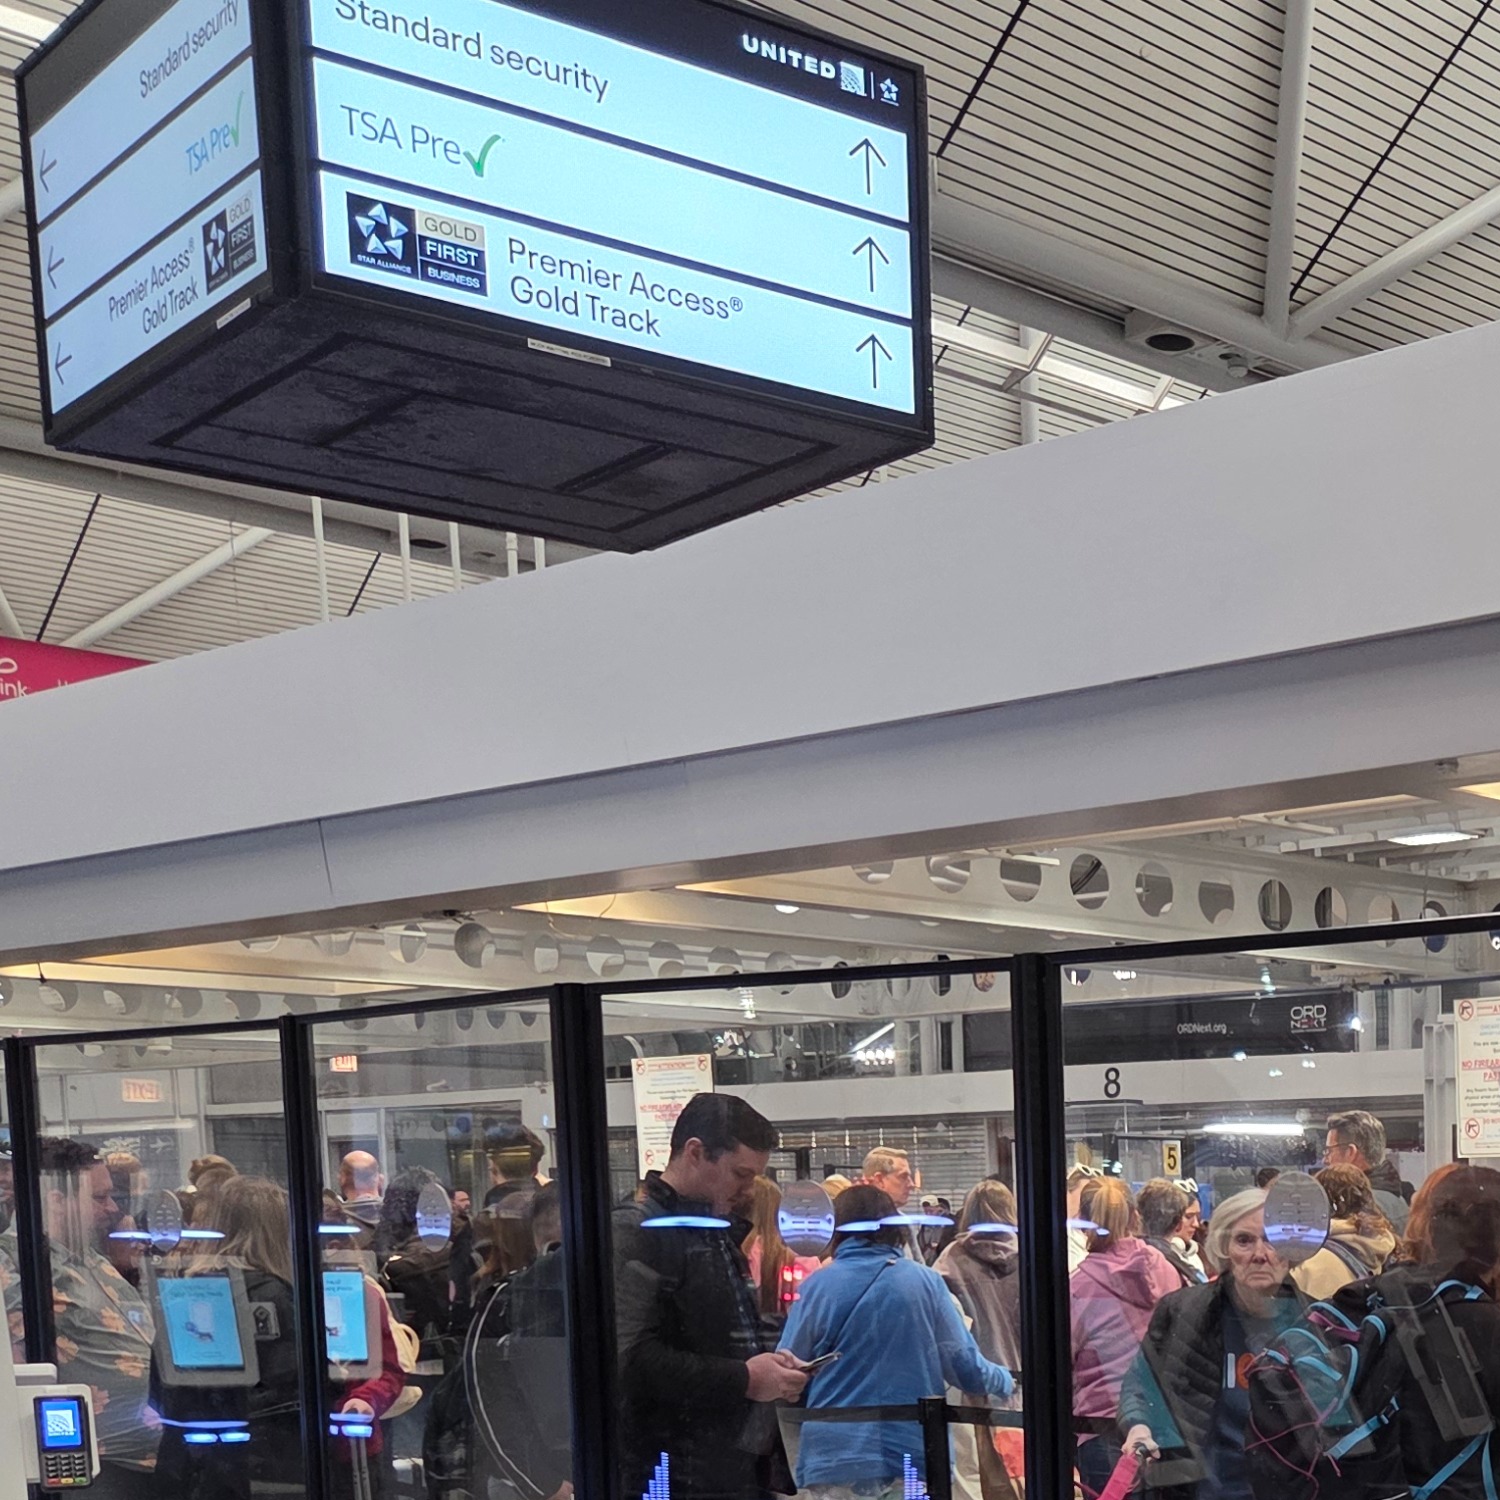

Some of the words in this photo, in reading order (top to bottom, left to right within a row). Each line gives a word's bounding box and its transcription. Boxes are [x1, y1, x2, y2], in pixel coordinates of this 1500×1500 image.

[139, 31, 191, 98] Standard
[191, 0, 238, 54] security
[335, 0, 482, 59] Standard
[490, 44, 608, 103] security
[742, 33, 836, 79] UNITED
[340, 105, 402, 149] TSA
[411, 125, 461, 164] Pre
[186, 137, 210, 175] TSA
[210, 124, 230, 158] Pre
[229, 198, 252, 223] GOLD
[231, 222, 253, 247] FIRST
[424, 217, 477, 242] GOLD
[357, 255, 377, 265] STAR
[377, 259, 412, 274] ALLIANCE
[426, 240, 478, 267] FIRST
[508, 237, 623, 291] Premier
[428, 267, 481, 289] BUSINESS
[108, 278, 148, 321] Premier
[142, 299, 168, 334] Gold
[168, 276, 200, 316] Track
[511, 276, 579, 317] Gold
[585, 293, 661, 338] Track
[0, 678, 28, 698] ink
[1290, 1004, 1327, 1019] ORD
[1290, 1018, 1327, 1029] NEXT
[1176, 1022, 1228, 1036] ORDNext.org
[1462, 1060, 1472, 1068] NO
[1104, 1067, 1121, 1098] 8
[1168, 1146, 1177, 1171] 5
